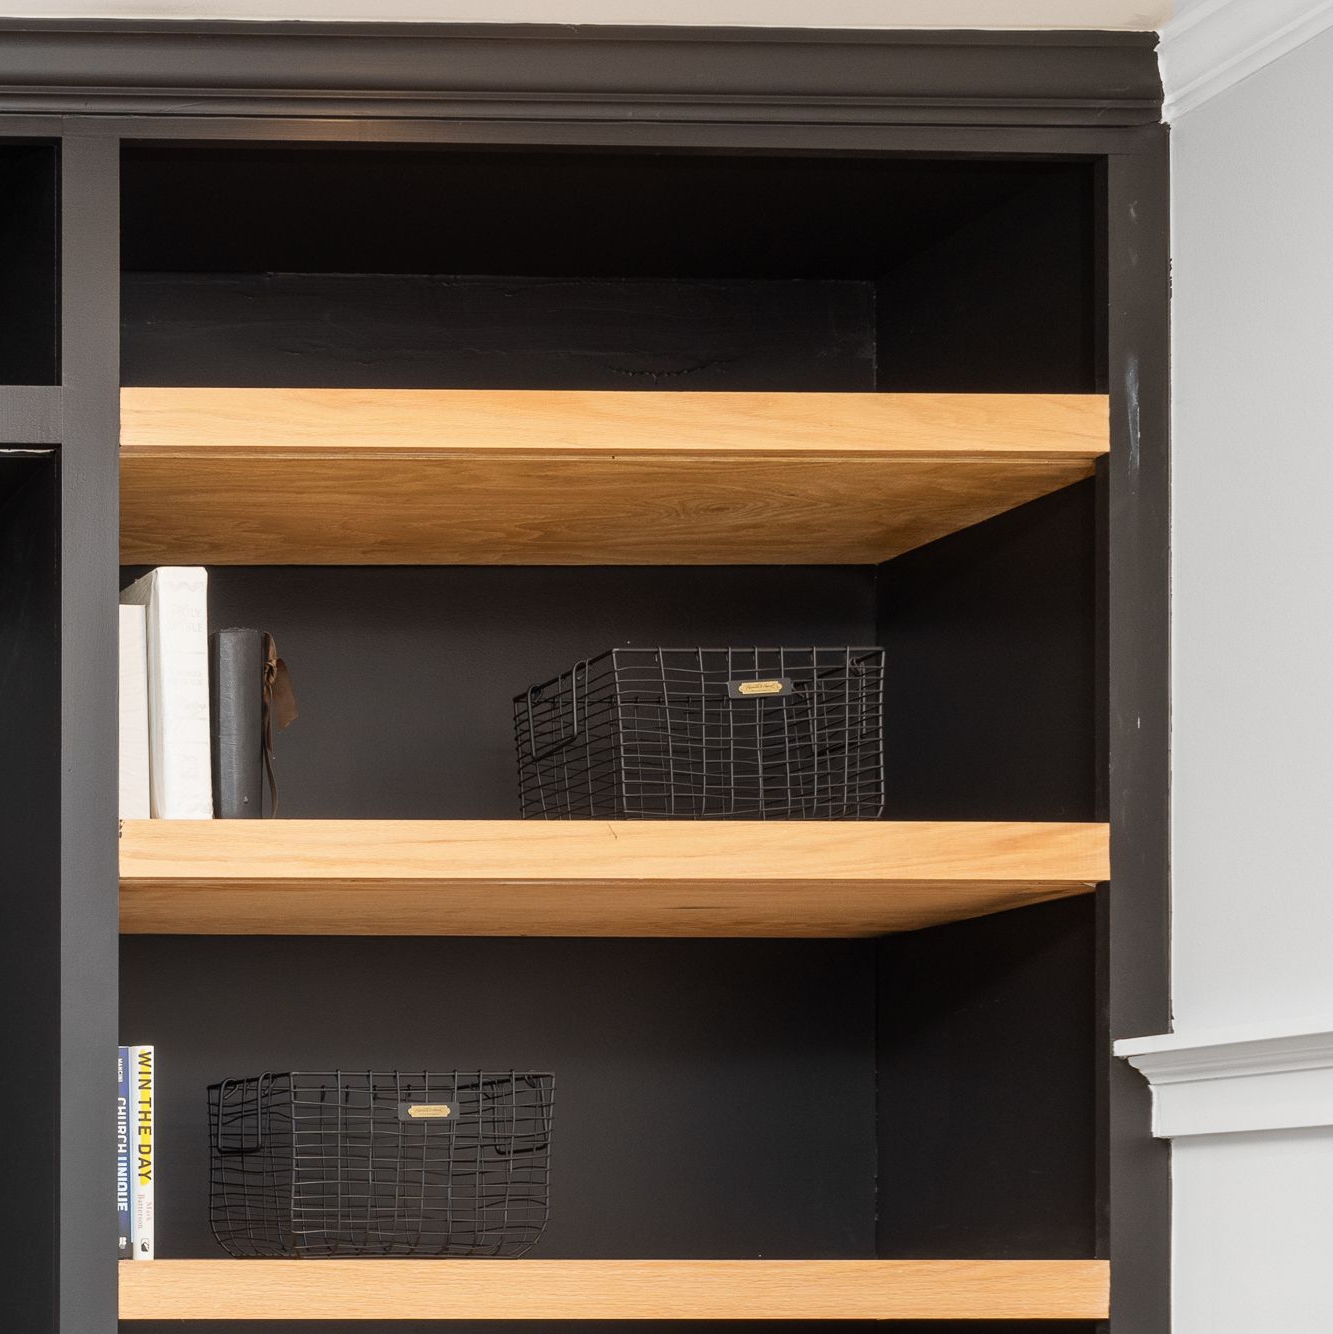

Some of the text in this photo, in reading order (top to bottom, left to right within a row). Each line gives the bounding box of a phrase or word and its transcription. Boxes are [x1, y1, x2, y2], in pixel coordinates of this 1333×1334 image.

[138, 1051, 152, 1181] WIN THE DAY
[117, 1097, 128, 1211] CHURCH UNIQUE
[137, 1194, 145, 1229] Batterson
[145, 1201, 153, 1221] Mark
